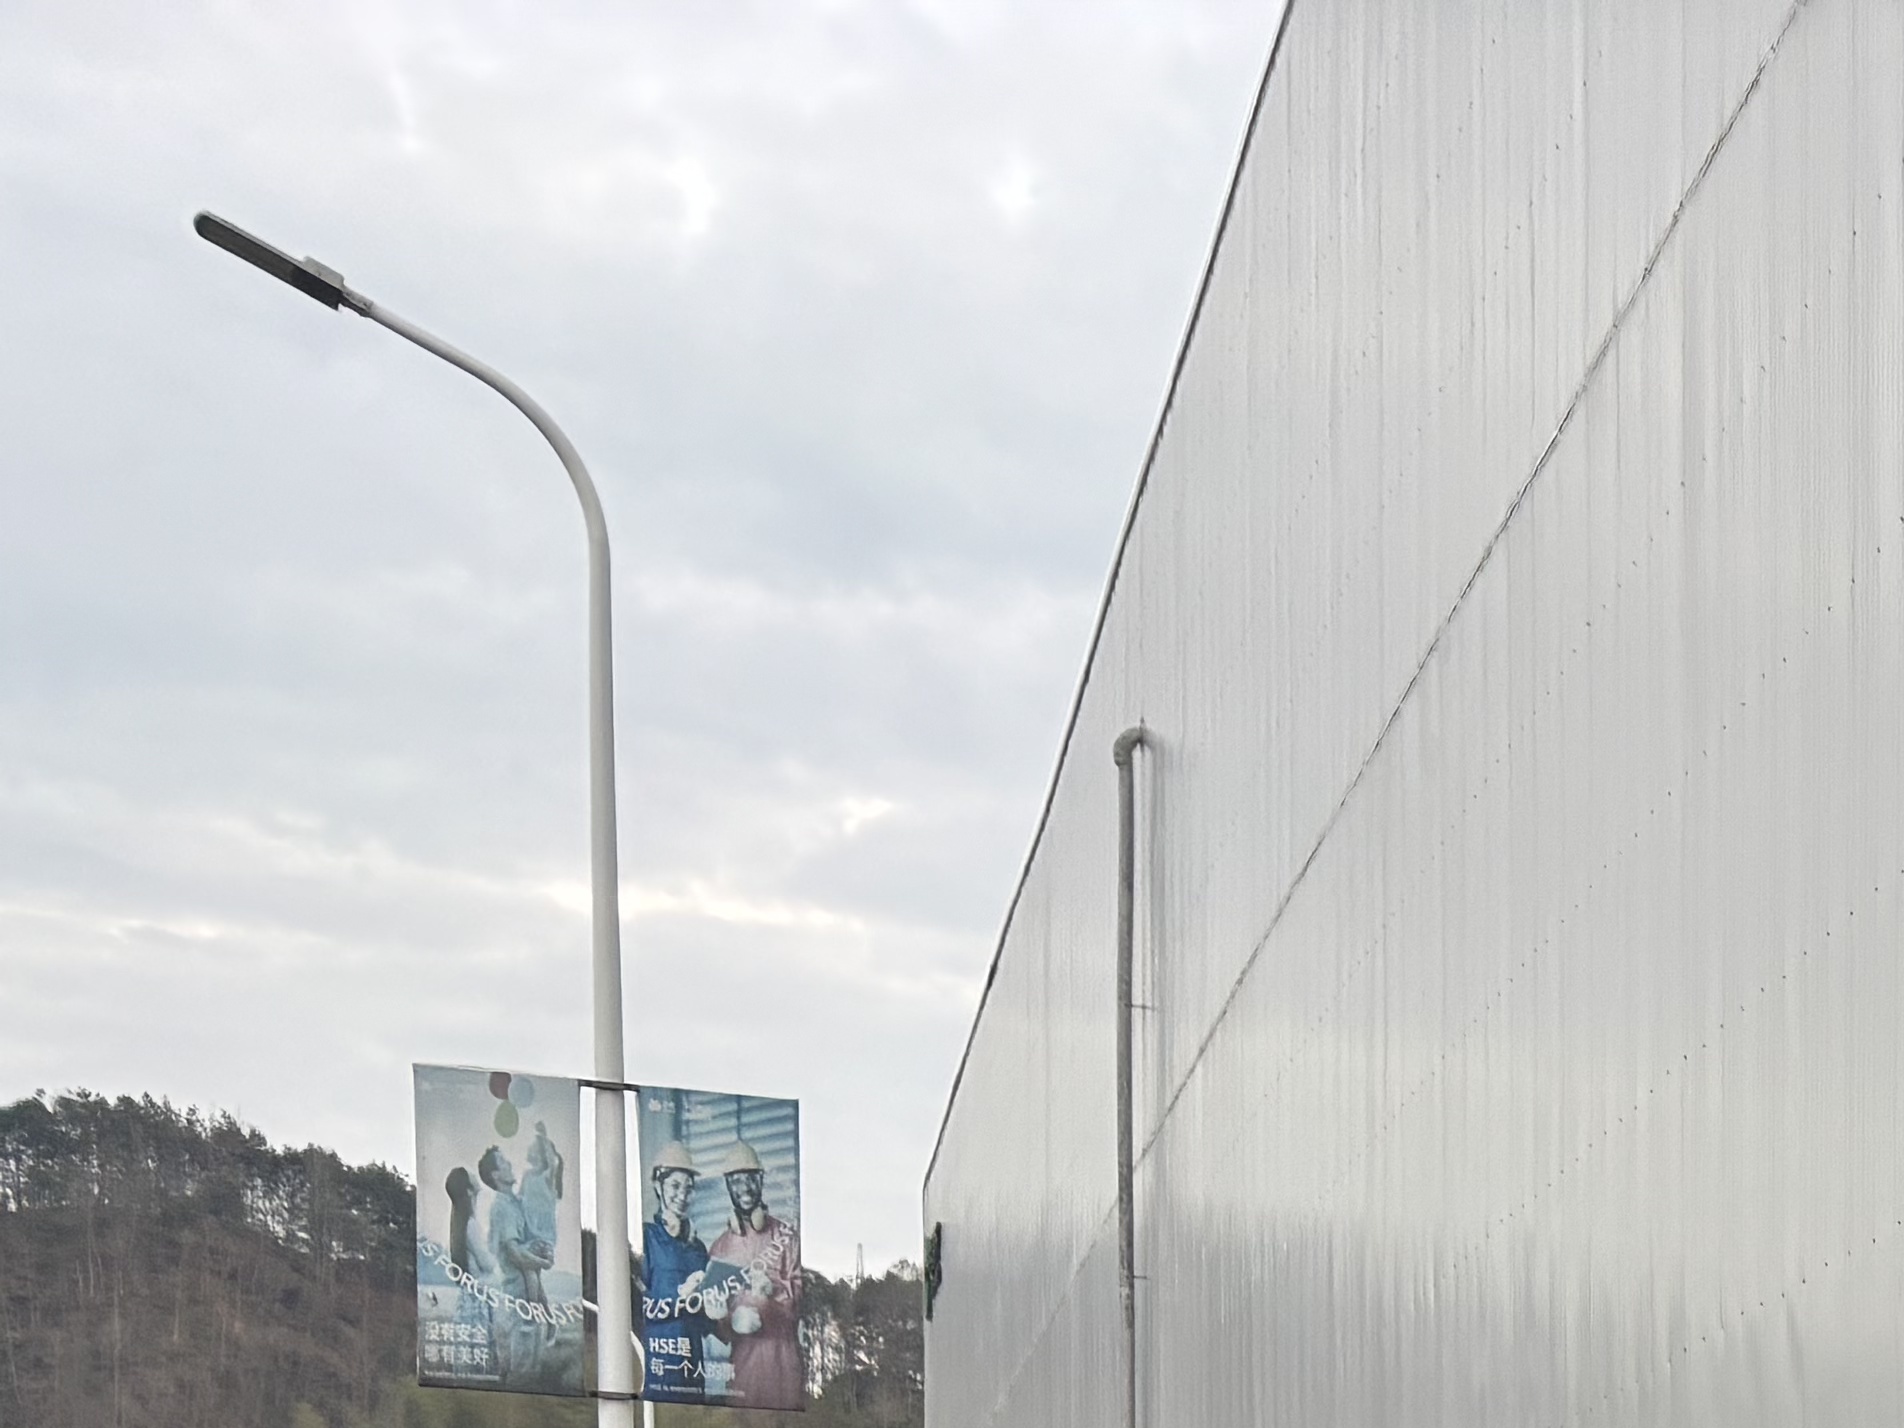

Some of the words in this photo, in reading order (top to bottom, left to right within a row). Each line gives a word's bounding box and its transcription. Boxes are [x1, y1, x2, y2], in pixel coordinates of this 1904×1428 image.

[433, 1254, 500, 1308] FORUS
[503, 1294, 567, 1326] FORUS
[674, 1275, 742, 1318] FORUS
[425, 1320, 488, 1345] 没有安全
[649, 1336, 692, 1357] HSE是
